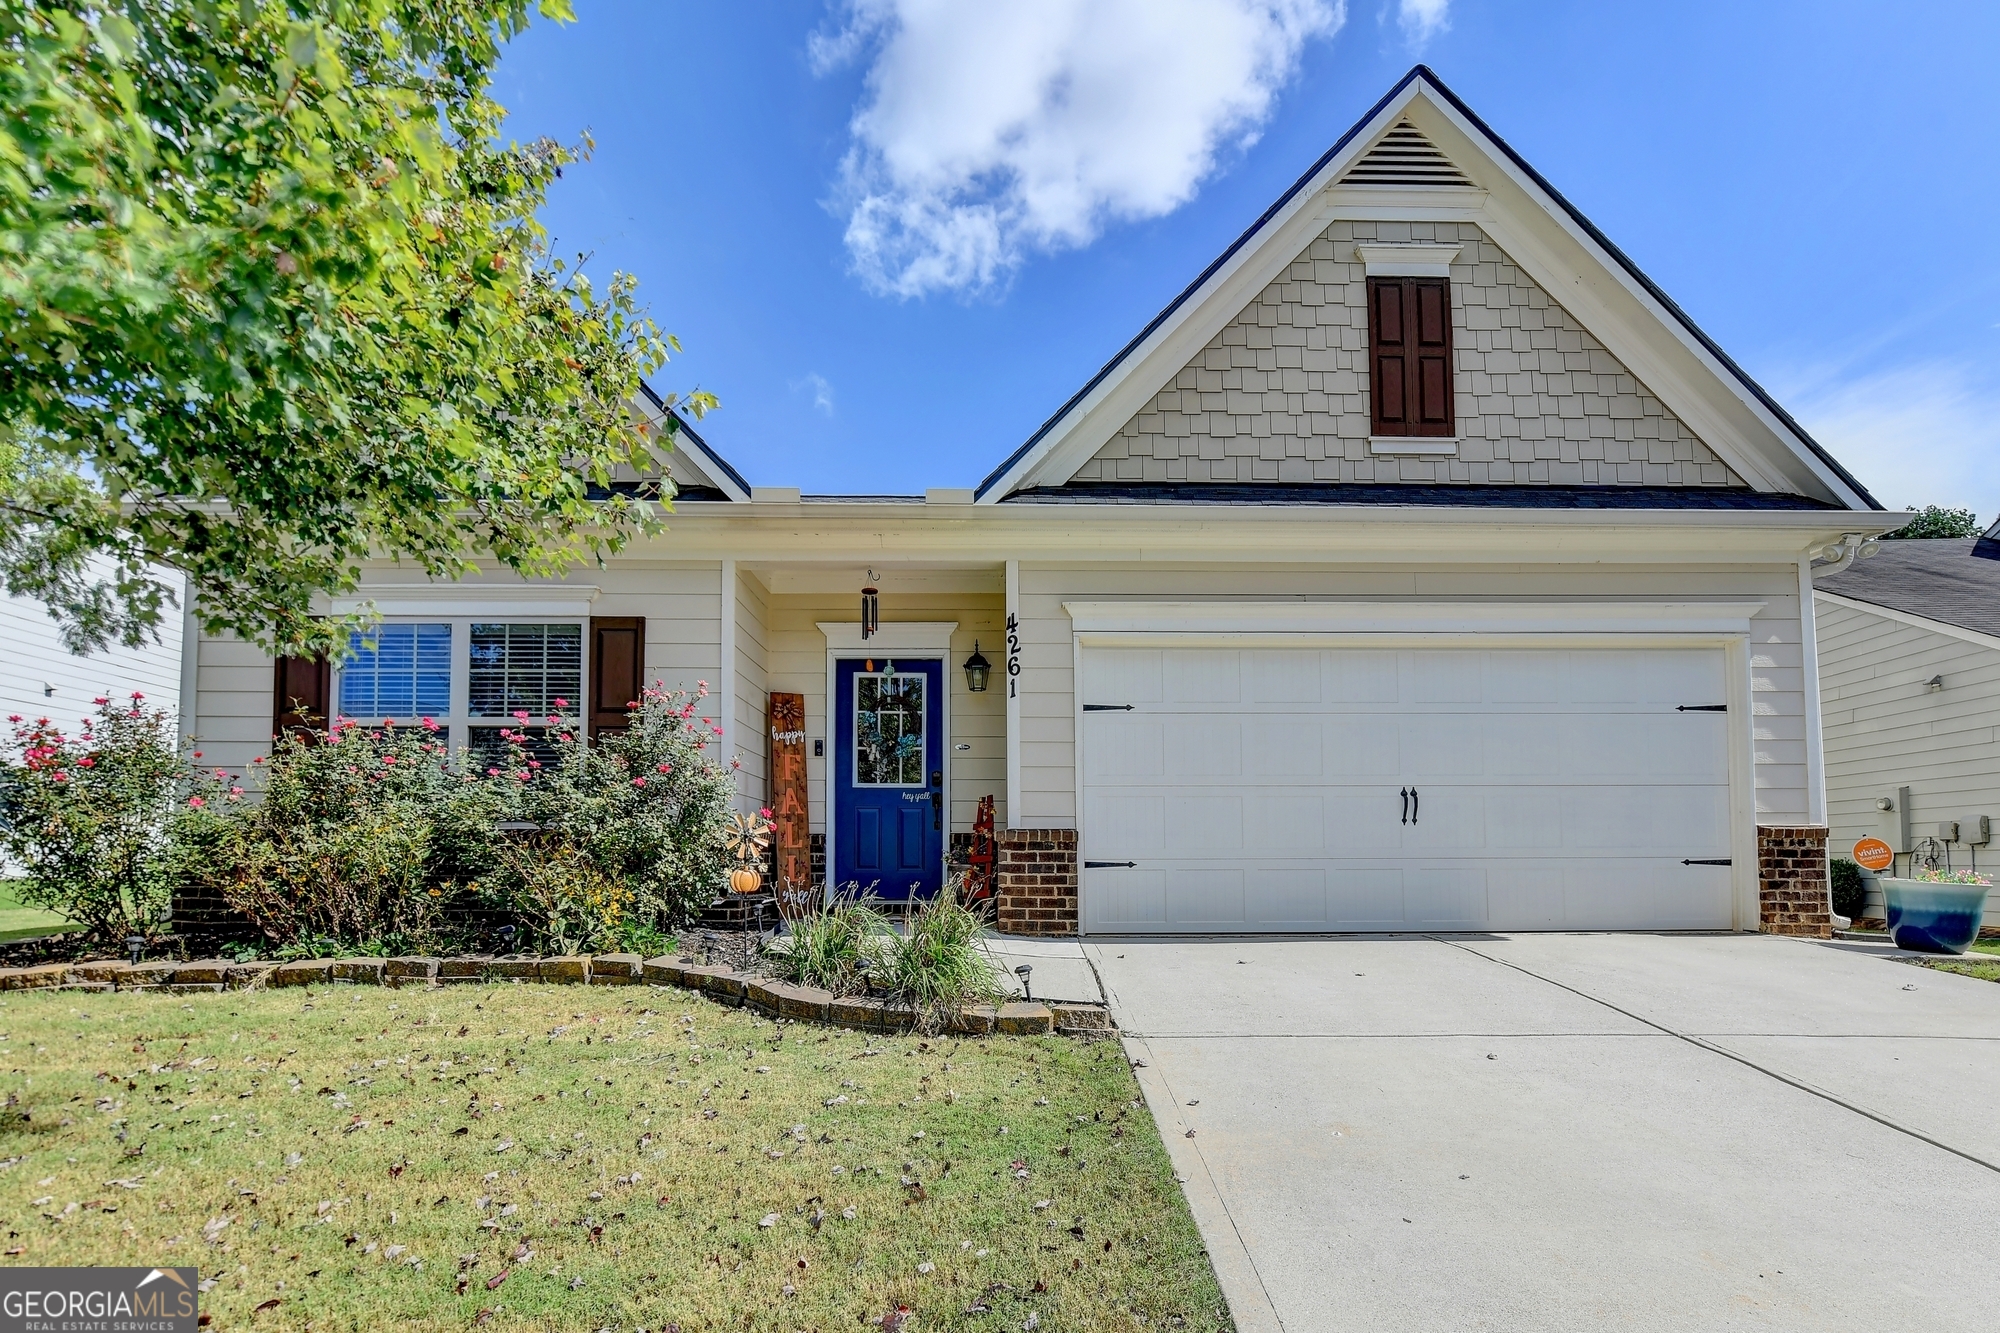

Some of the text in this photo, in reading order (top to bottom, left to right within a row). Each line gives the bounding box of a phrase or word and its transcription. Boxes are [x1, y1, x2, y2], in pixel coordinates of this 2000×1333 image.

[1006, 612, 1021, 698] 4261
[771, 725, 805, 745] happy
[780, 753, 805, 882] FALL
[901, 791, 915, 803] hey
